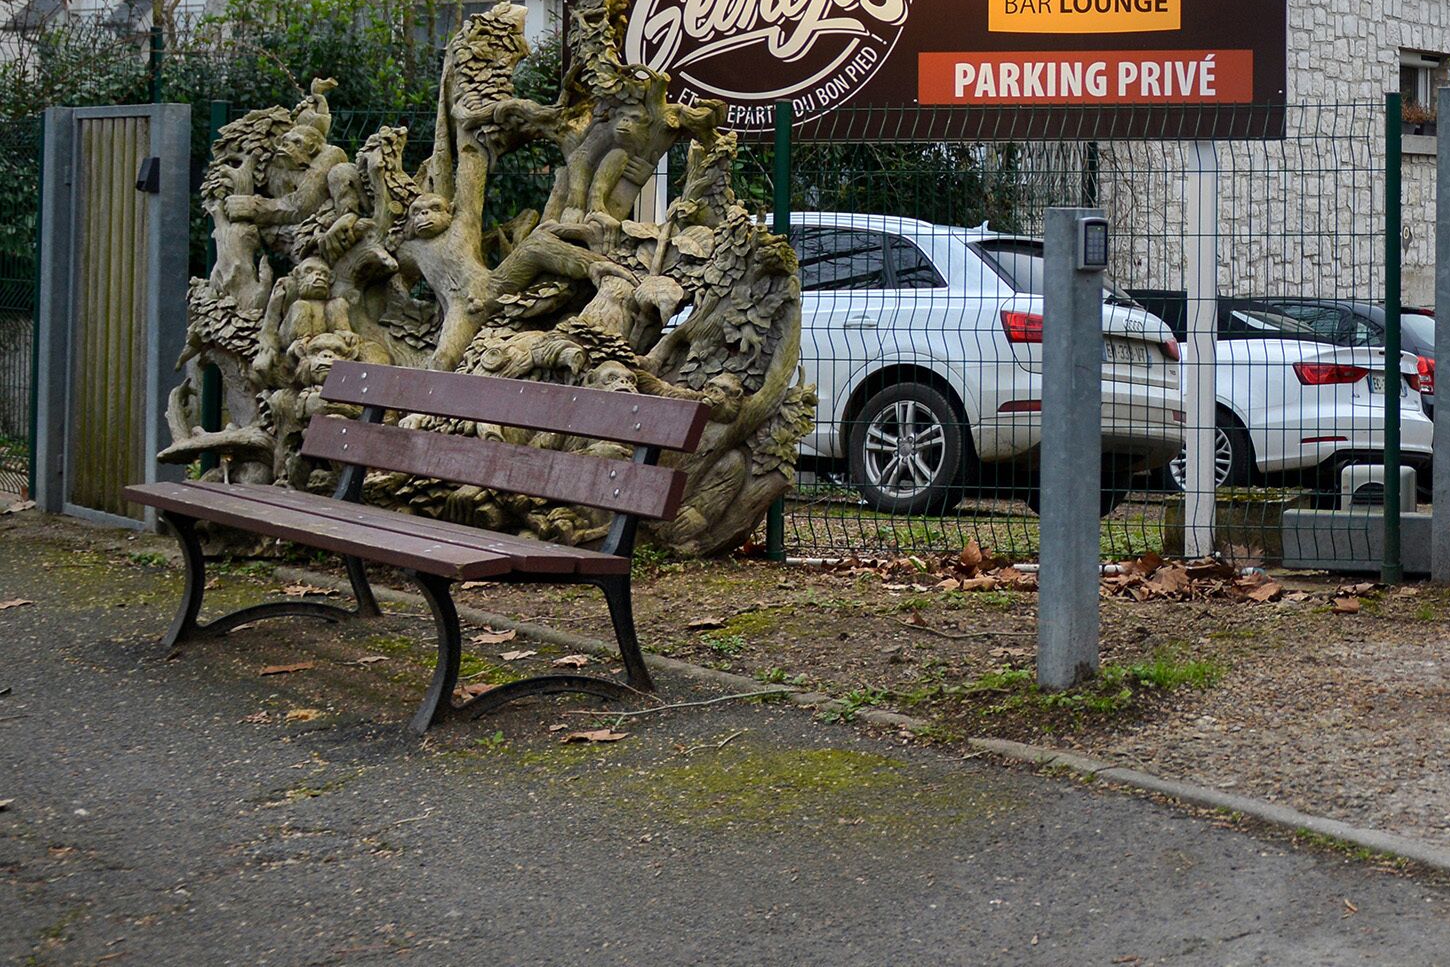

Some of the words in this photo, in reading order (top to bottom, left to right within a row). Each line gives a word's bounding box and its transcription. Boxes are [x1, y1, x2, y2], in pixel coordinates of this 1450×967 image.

[792, 97, 816, 118] DU
[815, 73, 850, 105] BON
[844, 45, 878, 83] PIED
[954, 61, 1107, 98] PARKING
[1117, 53, 1216, 97] PRIVÉ
